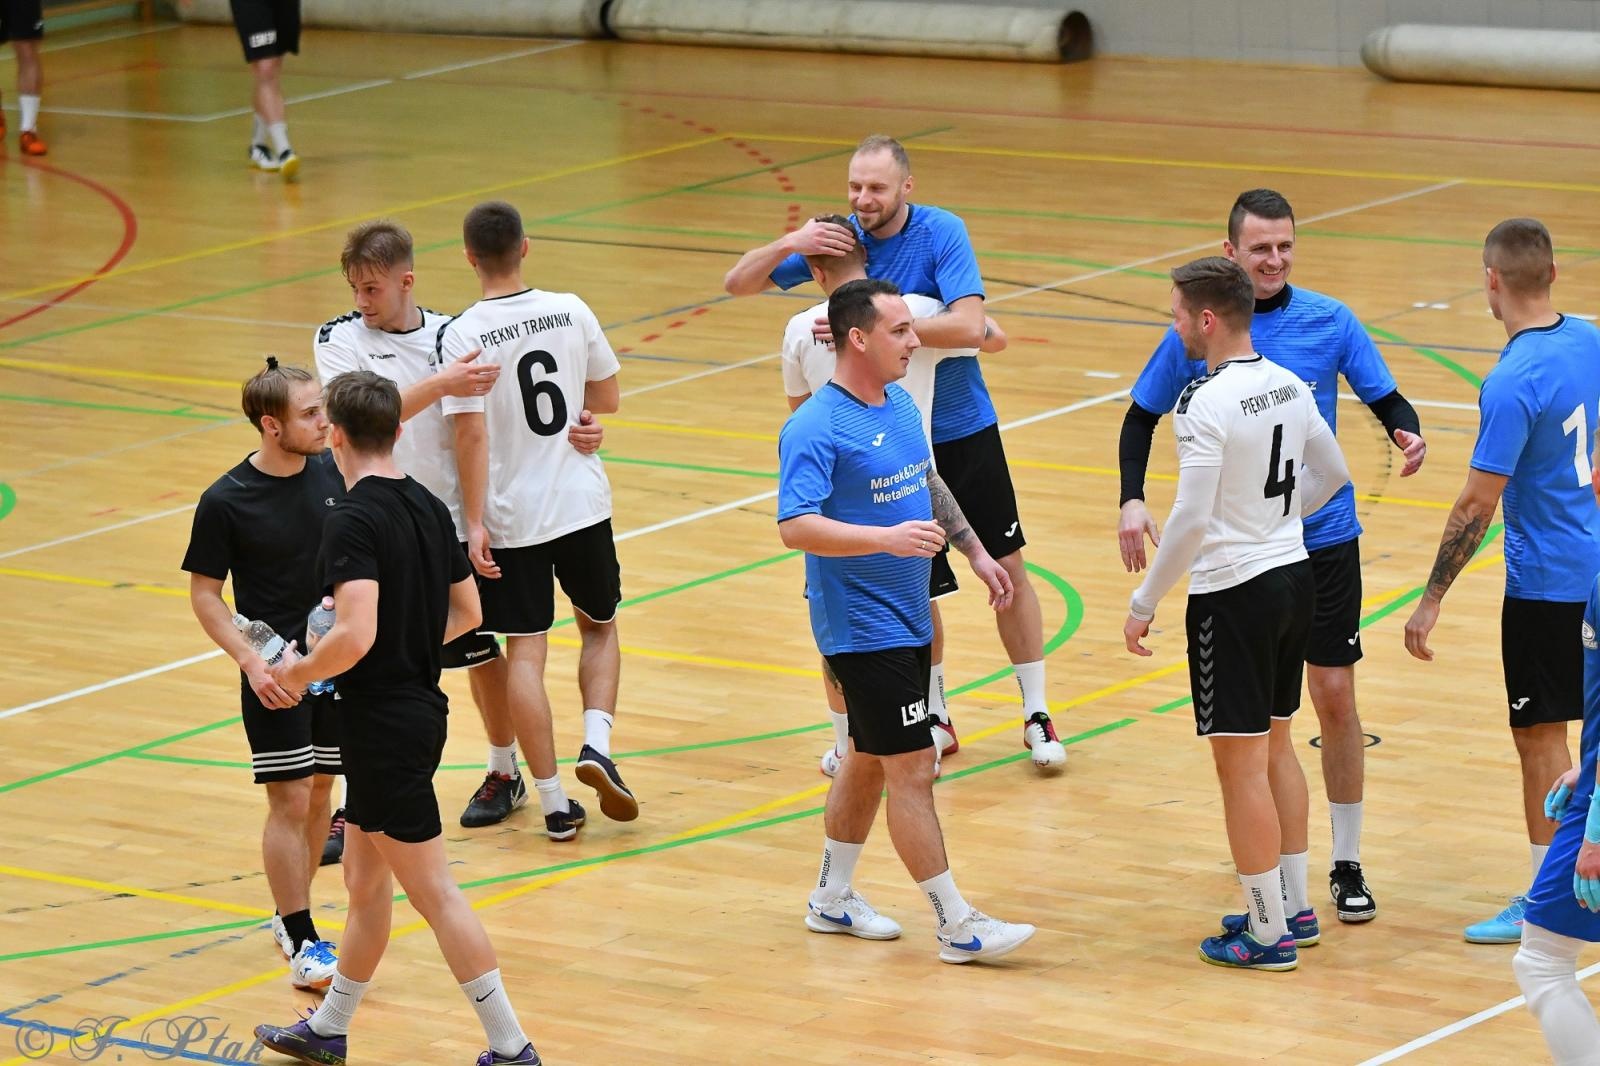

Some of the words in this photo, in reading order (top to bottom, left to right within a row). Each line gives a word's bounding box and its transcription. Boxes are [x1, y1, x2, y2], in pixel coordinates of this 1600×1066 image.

[480, 323, 520, 348] PIĘKNY
[522, 312, 573, 336] TRAWNIK
[517, 350, 568, 437] 6
[1240, 393, 1270, 416] PIĘKNY
[1562, 397, 1600, 488] 1
[870, 457, 930, 491] Marek&Dariu
[1264, 423, 1296, 517] 4
[873, 482, 920, 504] Metallbau
